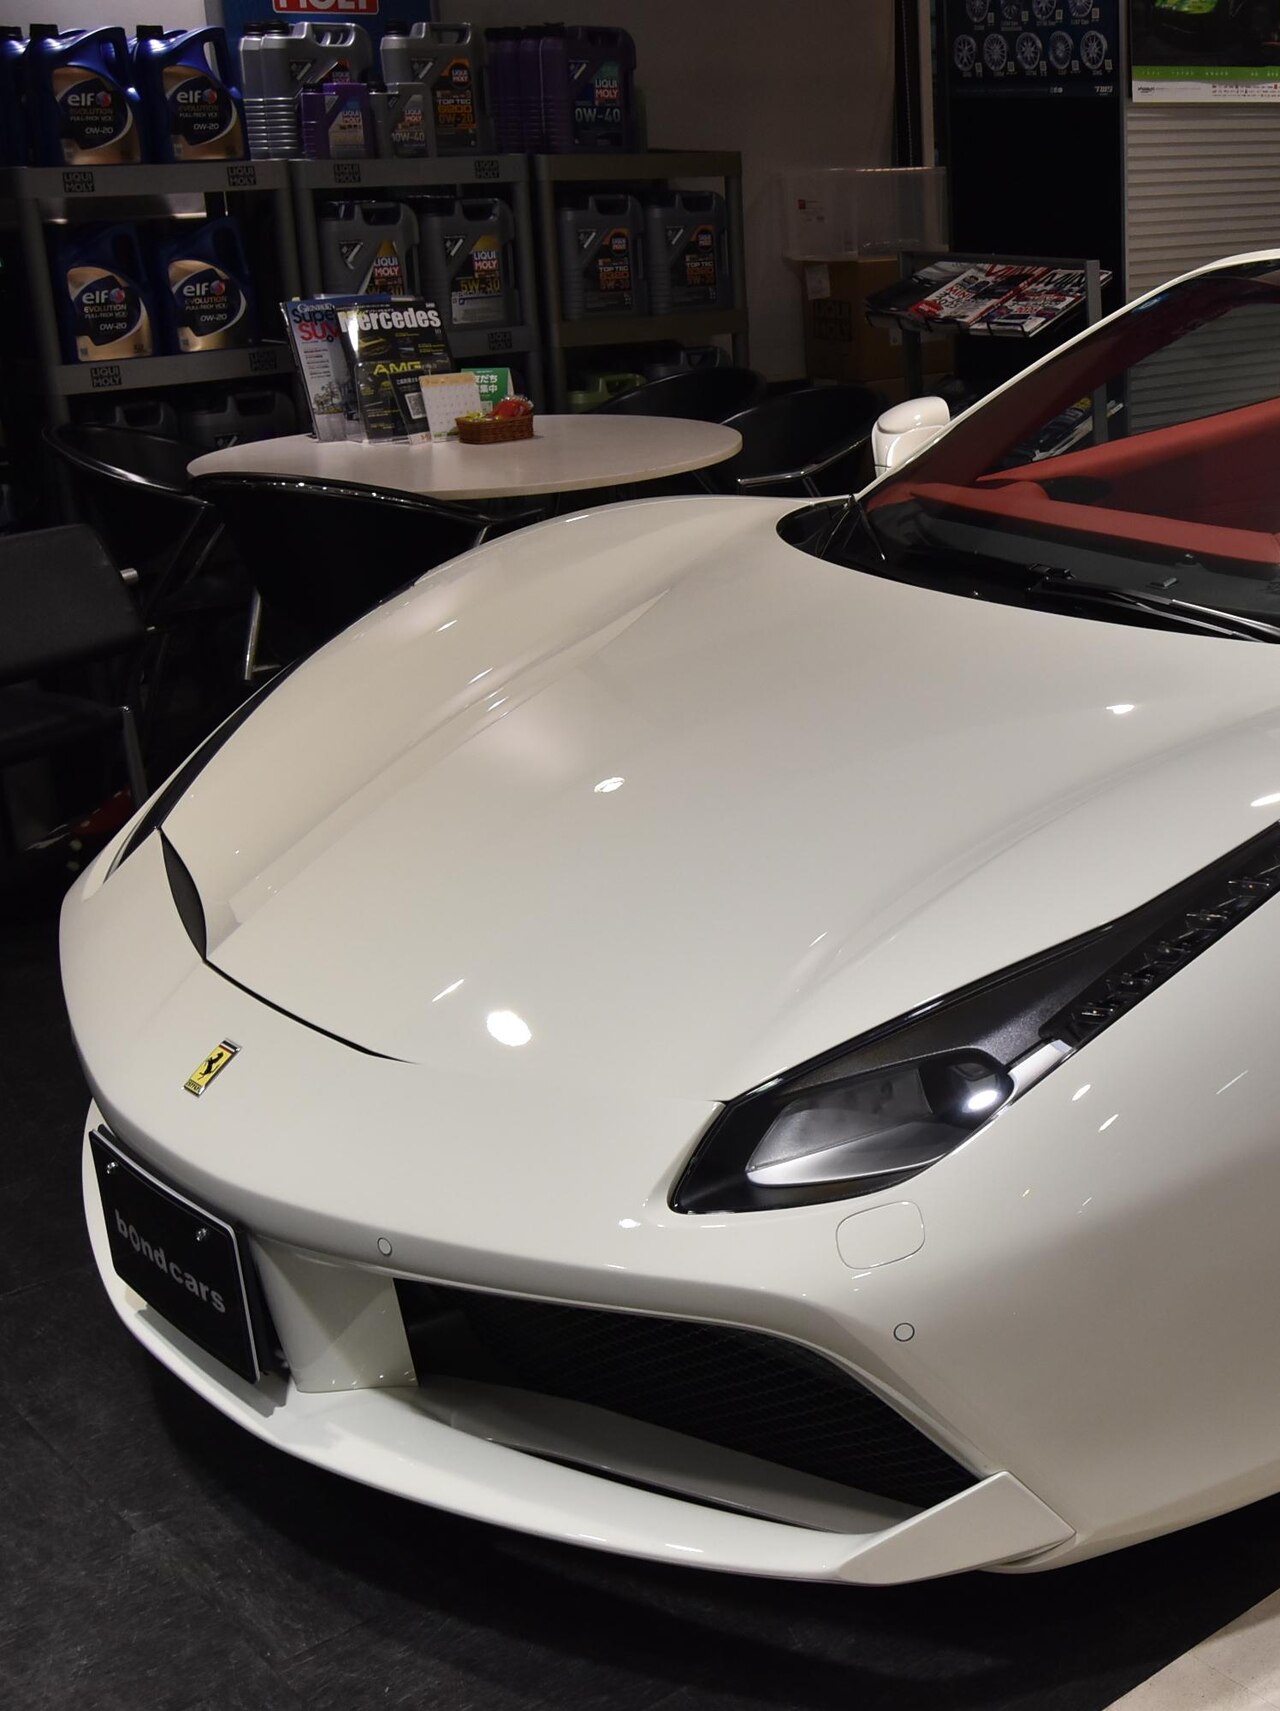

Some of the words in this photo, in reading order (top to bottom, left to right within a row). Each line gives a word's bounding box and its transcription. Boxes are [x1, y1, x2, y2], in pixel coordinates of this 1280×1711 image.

[594, 80, 618, 88] LIQUI
[176, 90, 203, 103] elf
[595, 89, 619, 98] MOLY
[67, 93, 95, 106] elf
[575, 108, 621, 122] 0W-40
[85, 126, 114, 135] 0W-20
[193, 122, 220, 130] 0W-20
[63, 173, 92, 181] LIQUI
[65, 183, 94, 192] MOLY
[473, 251, 496, 260] LIQUI
[374, 256, 398, 266] LIQUI
[474, 260, 498, 270] MOLY
[374, 267, 400, 277] MOLY
[183, 282, 209, 296] elf
[461, 279, 500, 293] 5W-30
[82, 290, 109, 304] elf
[200, 313, 227, 322] 0W-20
[292, 308, 335, 325] Supe
[337, 308, 441, 332] Mercedes
[100, 321, 127, 331] 0W-20
[92, 367, 119, 376] LIQUI
[373, 361, 422, 375] AMG
[94, 377, 121, 387] MOLY
